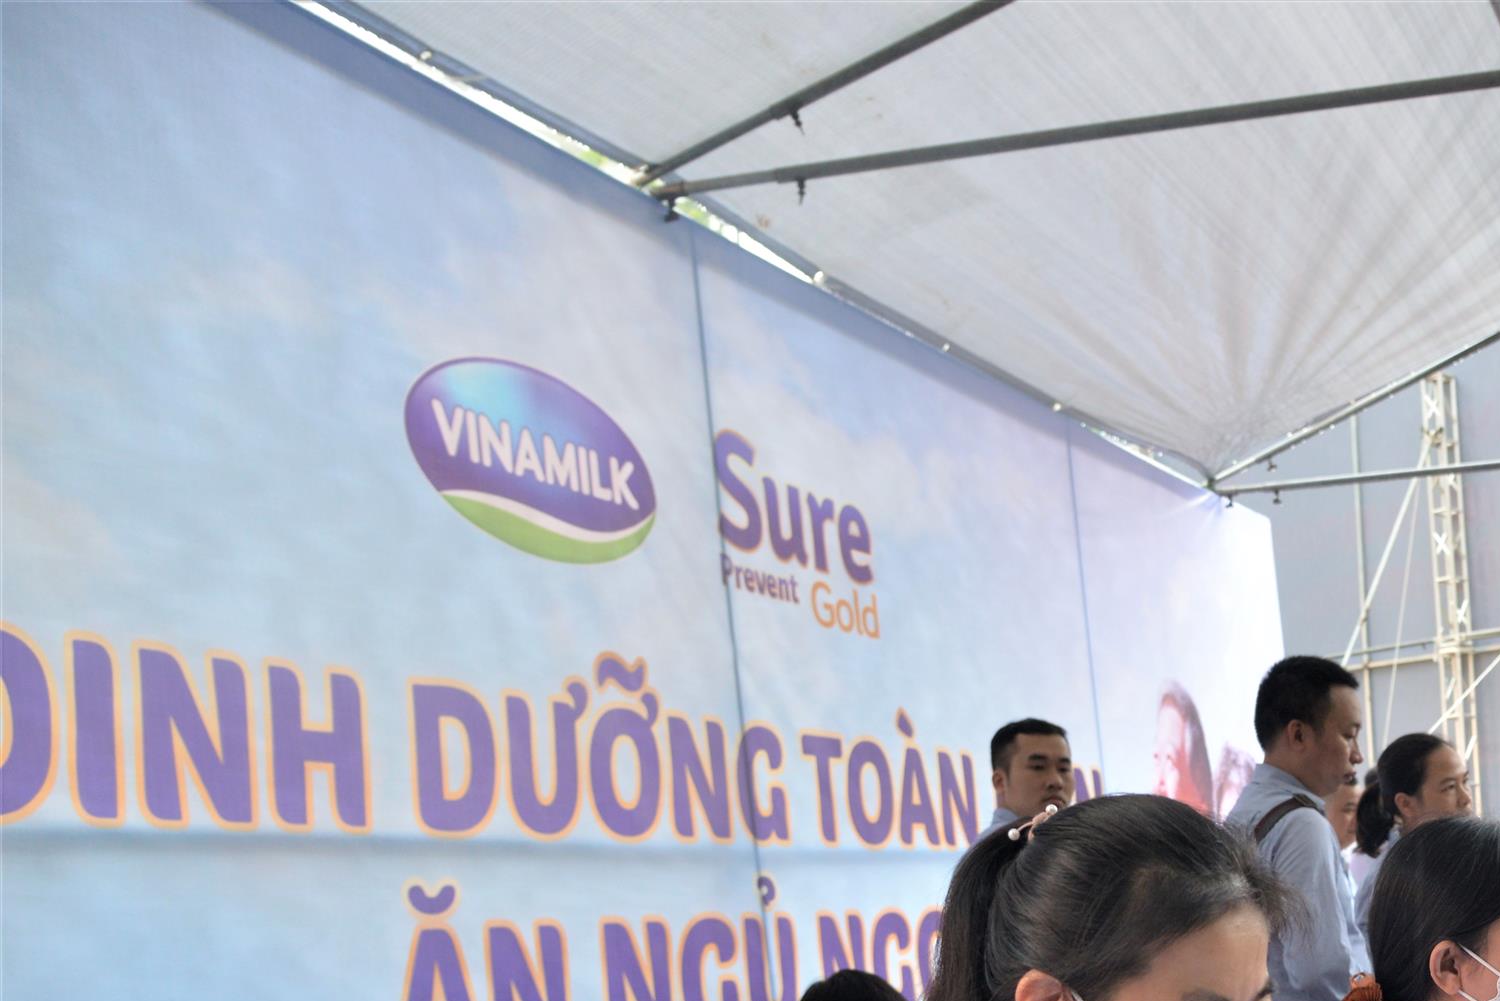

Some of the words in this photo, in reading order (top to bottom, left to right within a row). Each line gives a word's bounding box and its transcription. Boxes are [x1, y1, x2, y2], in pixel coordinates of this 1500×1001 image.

[430, 396, 641, 511] VINAMILK
[714, 429, 874, 585] Sure
[720, 552, 800, 604] Prevent
[811, 580, 880, 639] Gold
[408, 652, 792, 844] DƯỠNG
[801, 708, 978, 849] TOÀN
